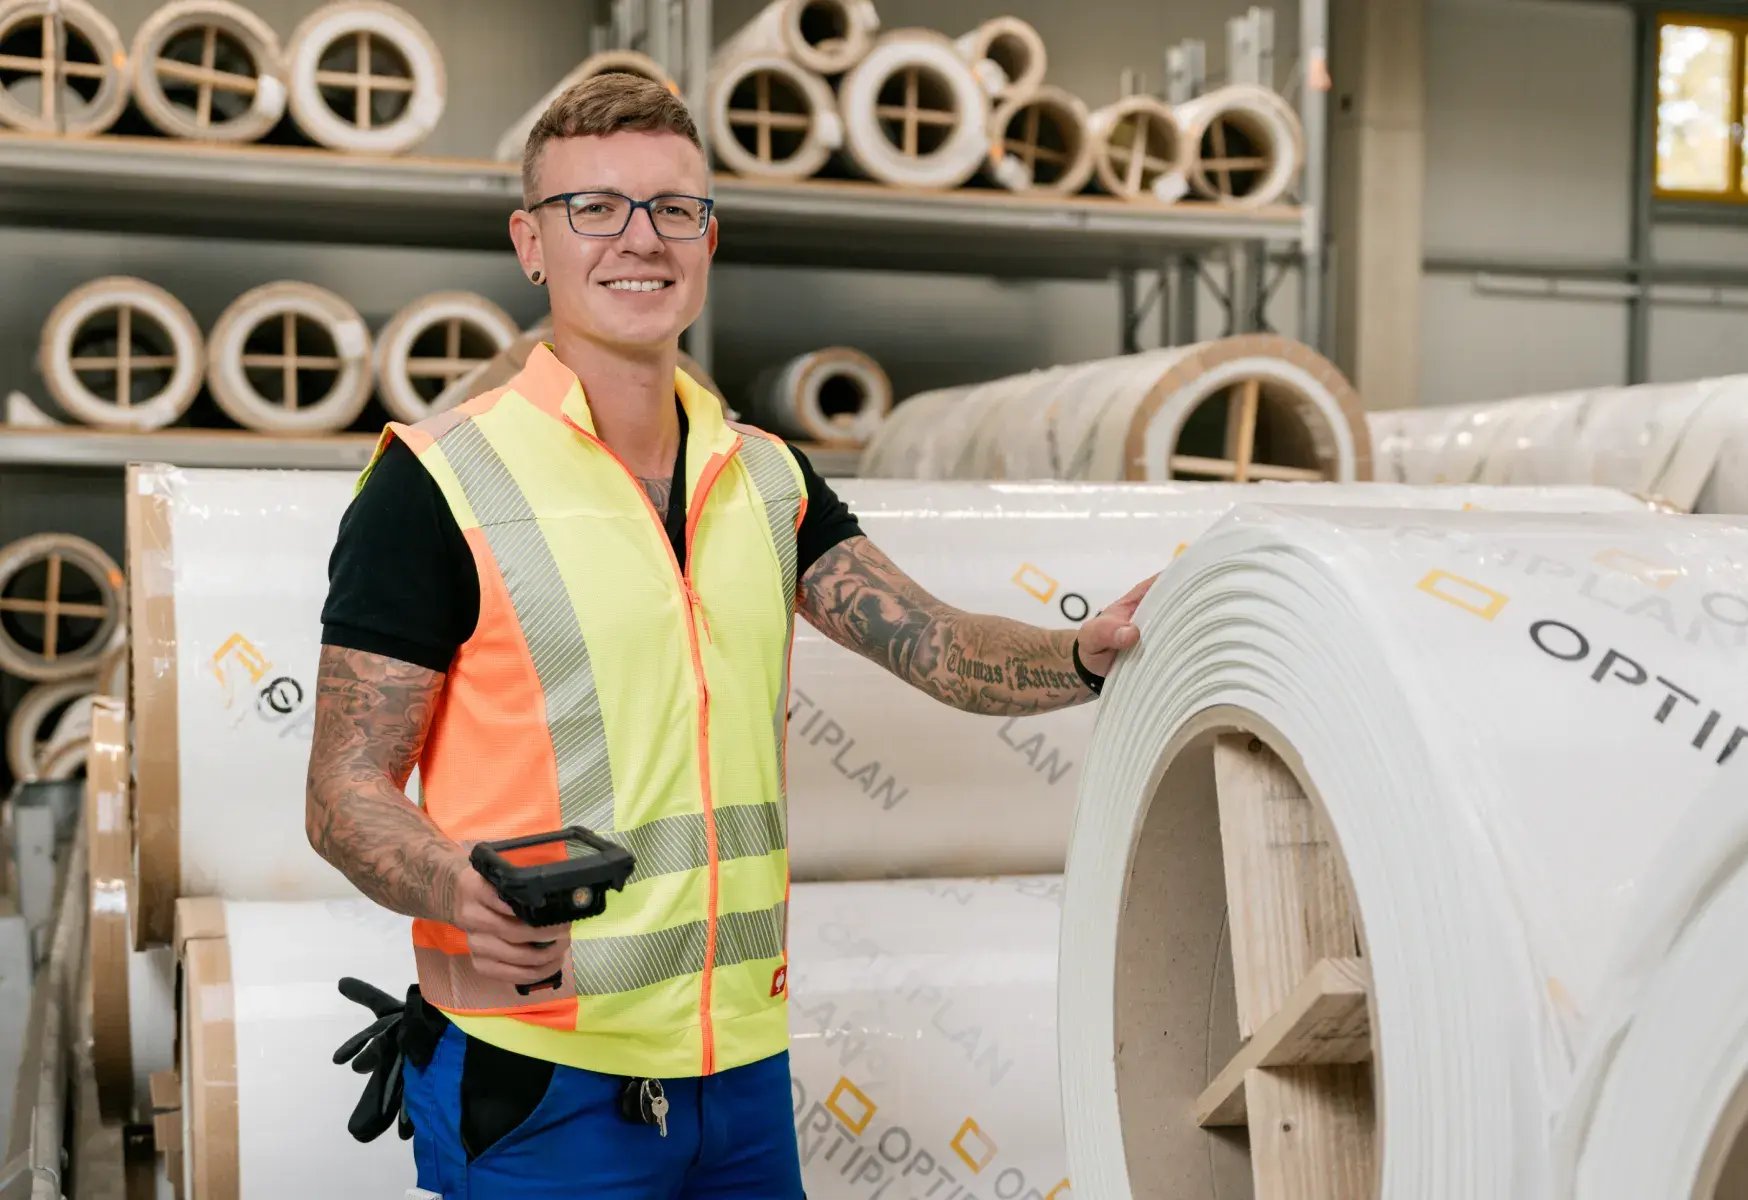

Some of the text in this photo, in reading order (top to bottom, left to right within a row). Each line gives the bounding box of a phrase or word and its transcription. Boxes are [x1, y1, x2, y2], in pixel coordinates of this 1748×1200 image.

[946, 643, 1003, 684] Thomas
[787, 689, 909, 812] TIPLAN
[996, 716, 1074, 787] LAN
